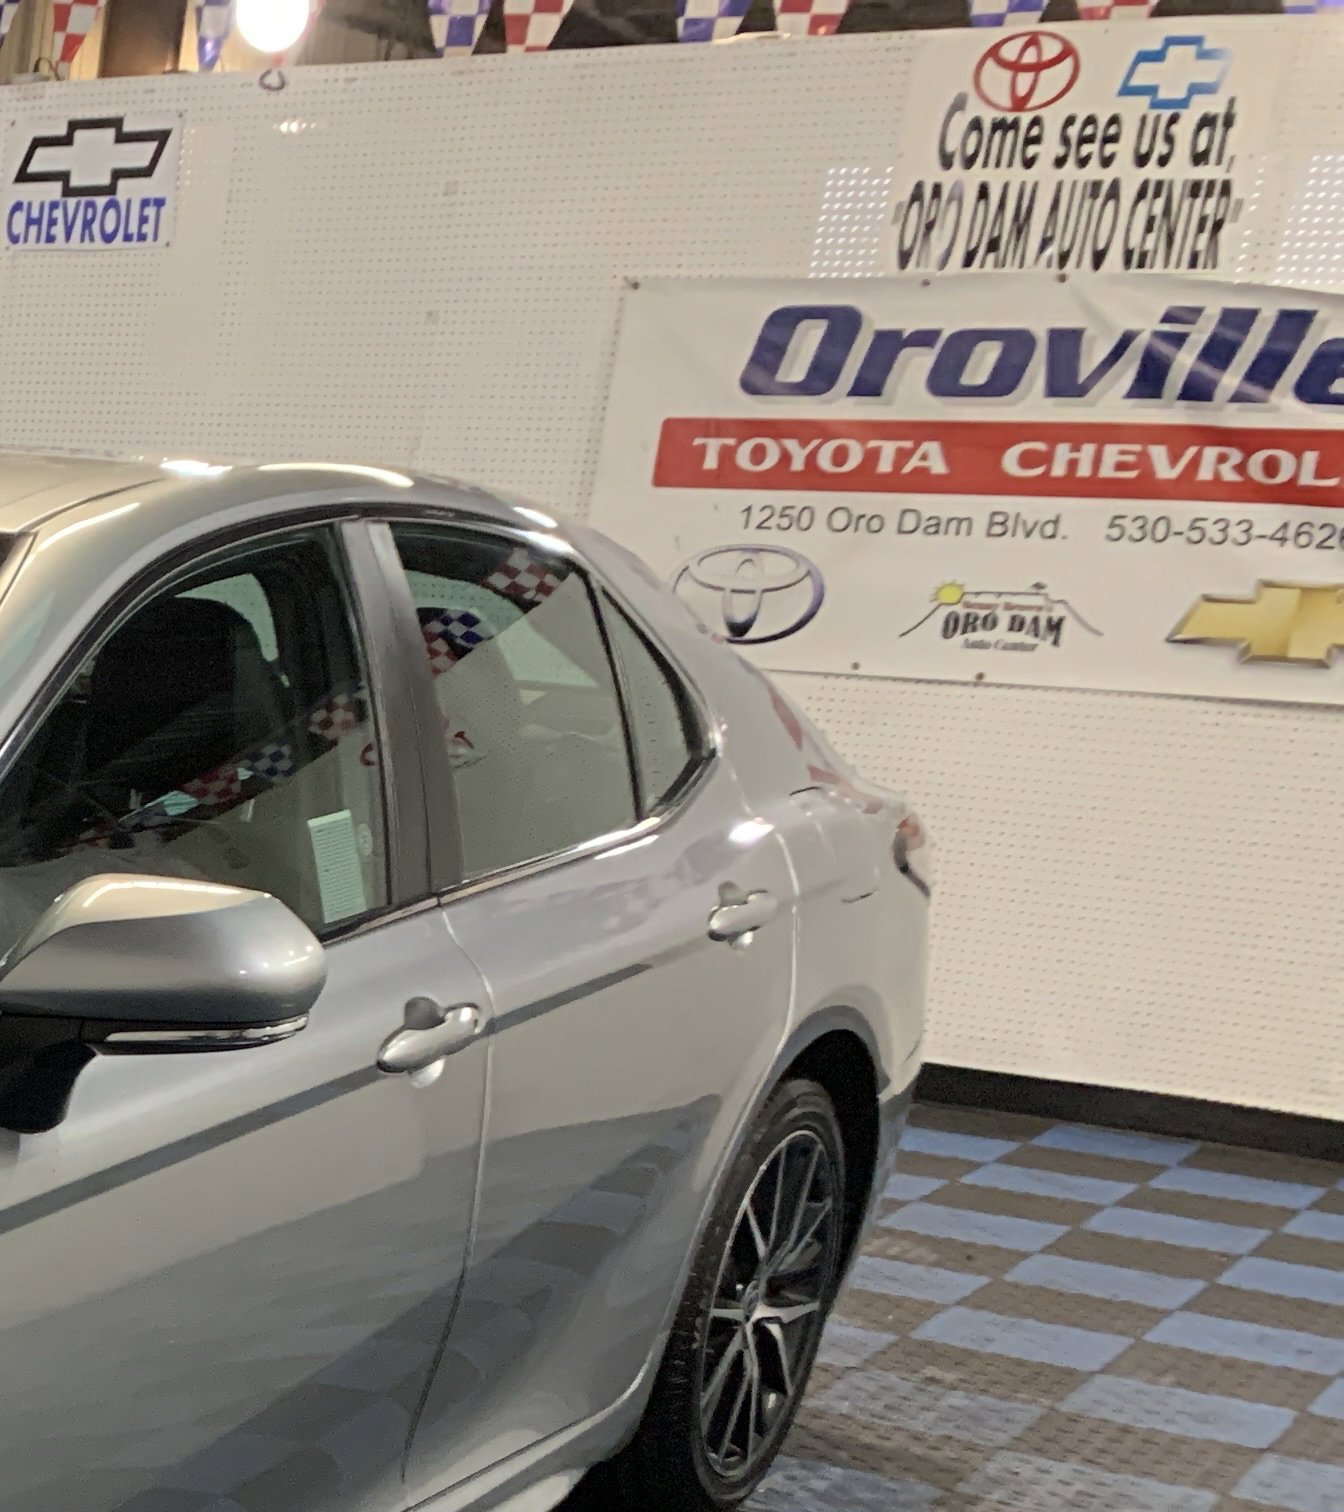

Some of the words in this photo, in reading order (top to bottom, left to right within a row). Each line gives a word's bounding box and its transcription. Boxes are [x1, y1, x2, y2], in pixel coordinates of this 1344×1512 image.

[938, 92, 1044, 170] Come
[1053, 112, 1122, 169] see
[1132, 112, 1181, 168] us
[6, 196, 167, 245] CHEVROLET
[961, 180, 1040, 270] DAM
[1034, 177, 1122, 271] AUTO
[692, 435, 950, 475] TOYOTA
[1001, 440, 1344, 488] CHEVROL
[739, 504, 815, 533] 1250
[826, 506, 886, 536] Oro
[897, 508, 973, 538] Dam
[986, 511, 1068, 541] Blvd.
[1103, 513, 1344, 551] 530-533-462
[941, 610, 999, 640] ORO
[1007, 613, 1067, 648] DAM
